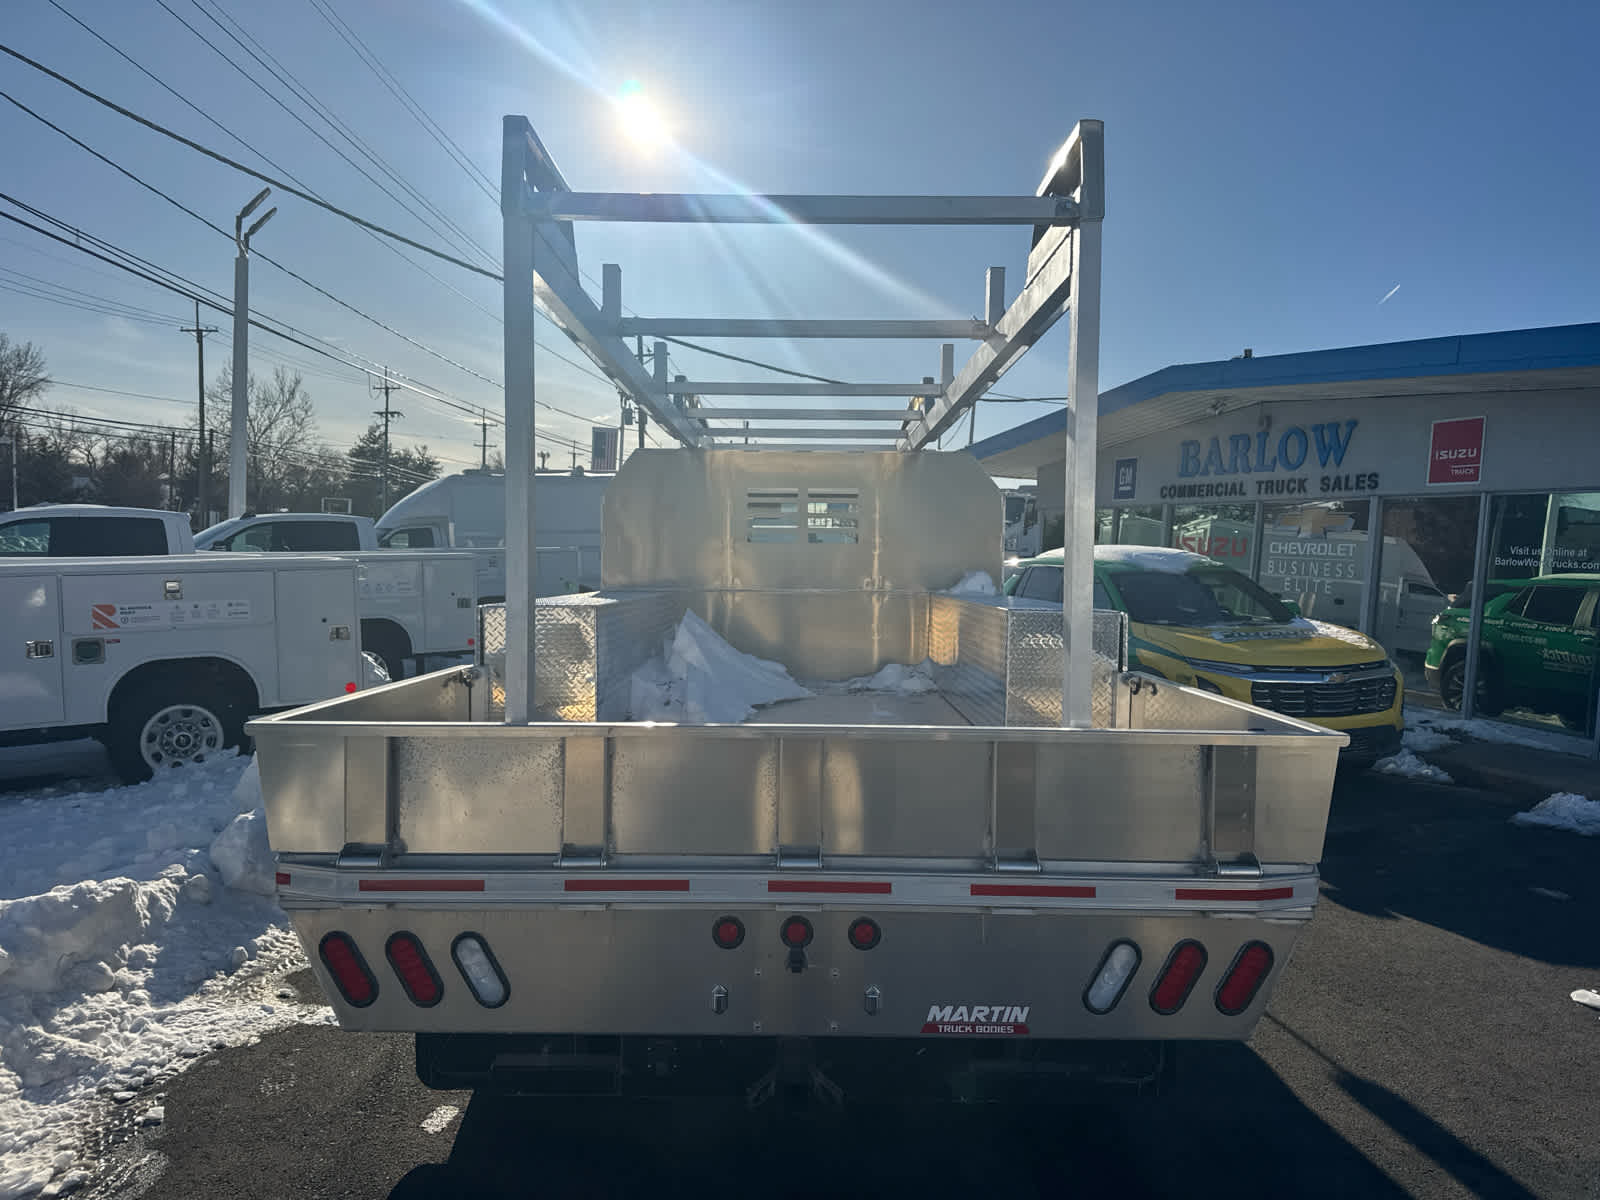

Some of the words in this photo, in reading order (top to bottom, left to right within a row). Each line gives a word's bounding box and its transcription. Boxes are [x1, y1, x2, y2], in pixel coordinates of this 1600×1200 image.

[1178, 419, 1358, 478] BARLOW
[1435, 448, 1477, 460] ISUZU
[1119, 465, 1133, 485] GM
[1451, 467, 1475, 475] TRUCK
[1160, 481, 1247, 499] COMMERCIAL
[1256, 478, 1308, 495] TRUCK
[1320, 472, 1379, 493] SALES
[1175, 536, 1249, 557] ISUZU
[1270, 542, 1356, 556] CHEVROLET
[1510, 546, 1529, 556] Visit
[1577, 547, 1588, 558] at
[1267, 560, 1356, 578] BUSINESS
[1284, 577, 1332, 594] ELITE
[926, 1005, 1030, 1022] MARTIN
[937, 1025, 973, 1033] TRUCK
[975, 1025, 1014, 1034] BODIES
